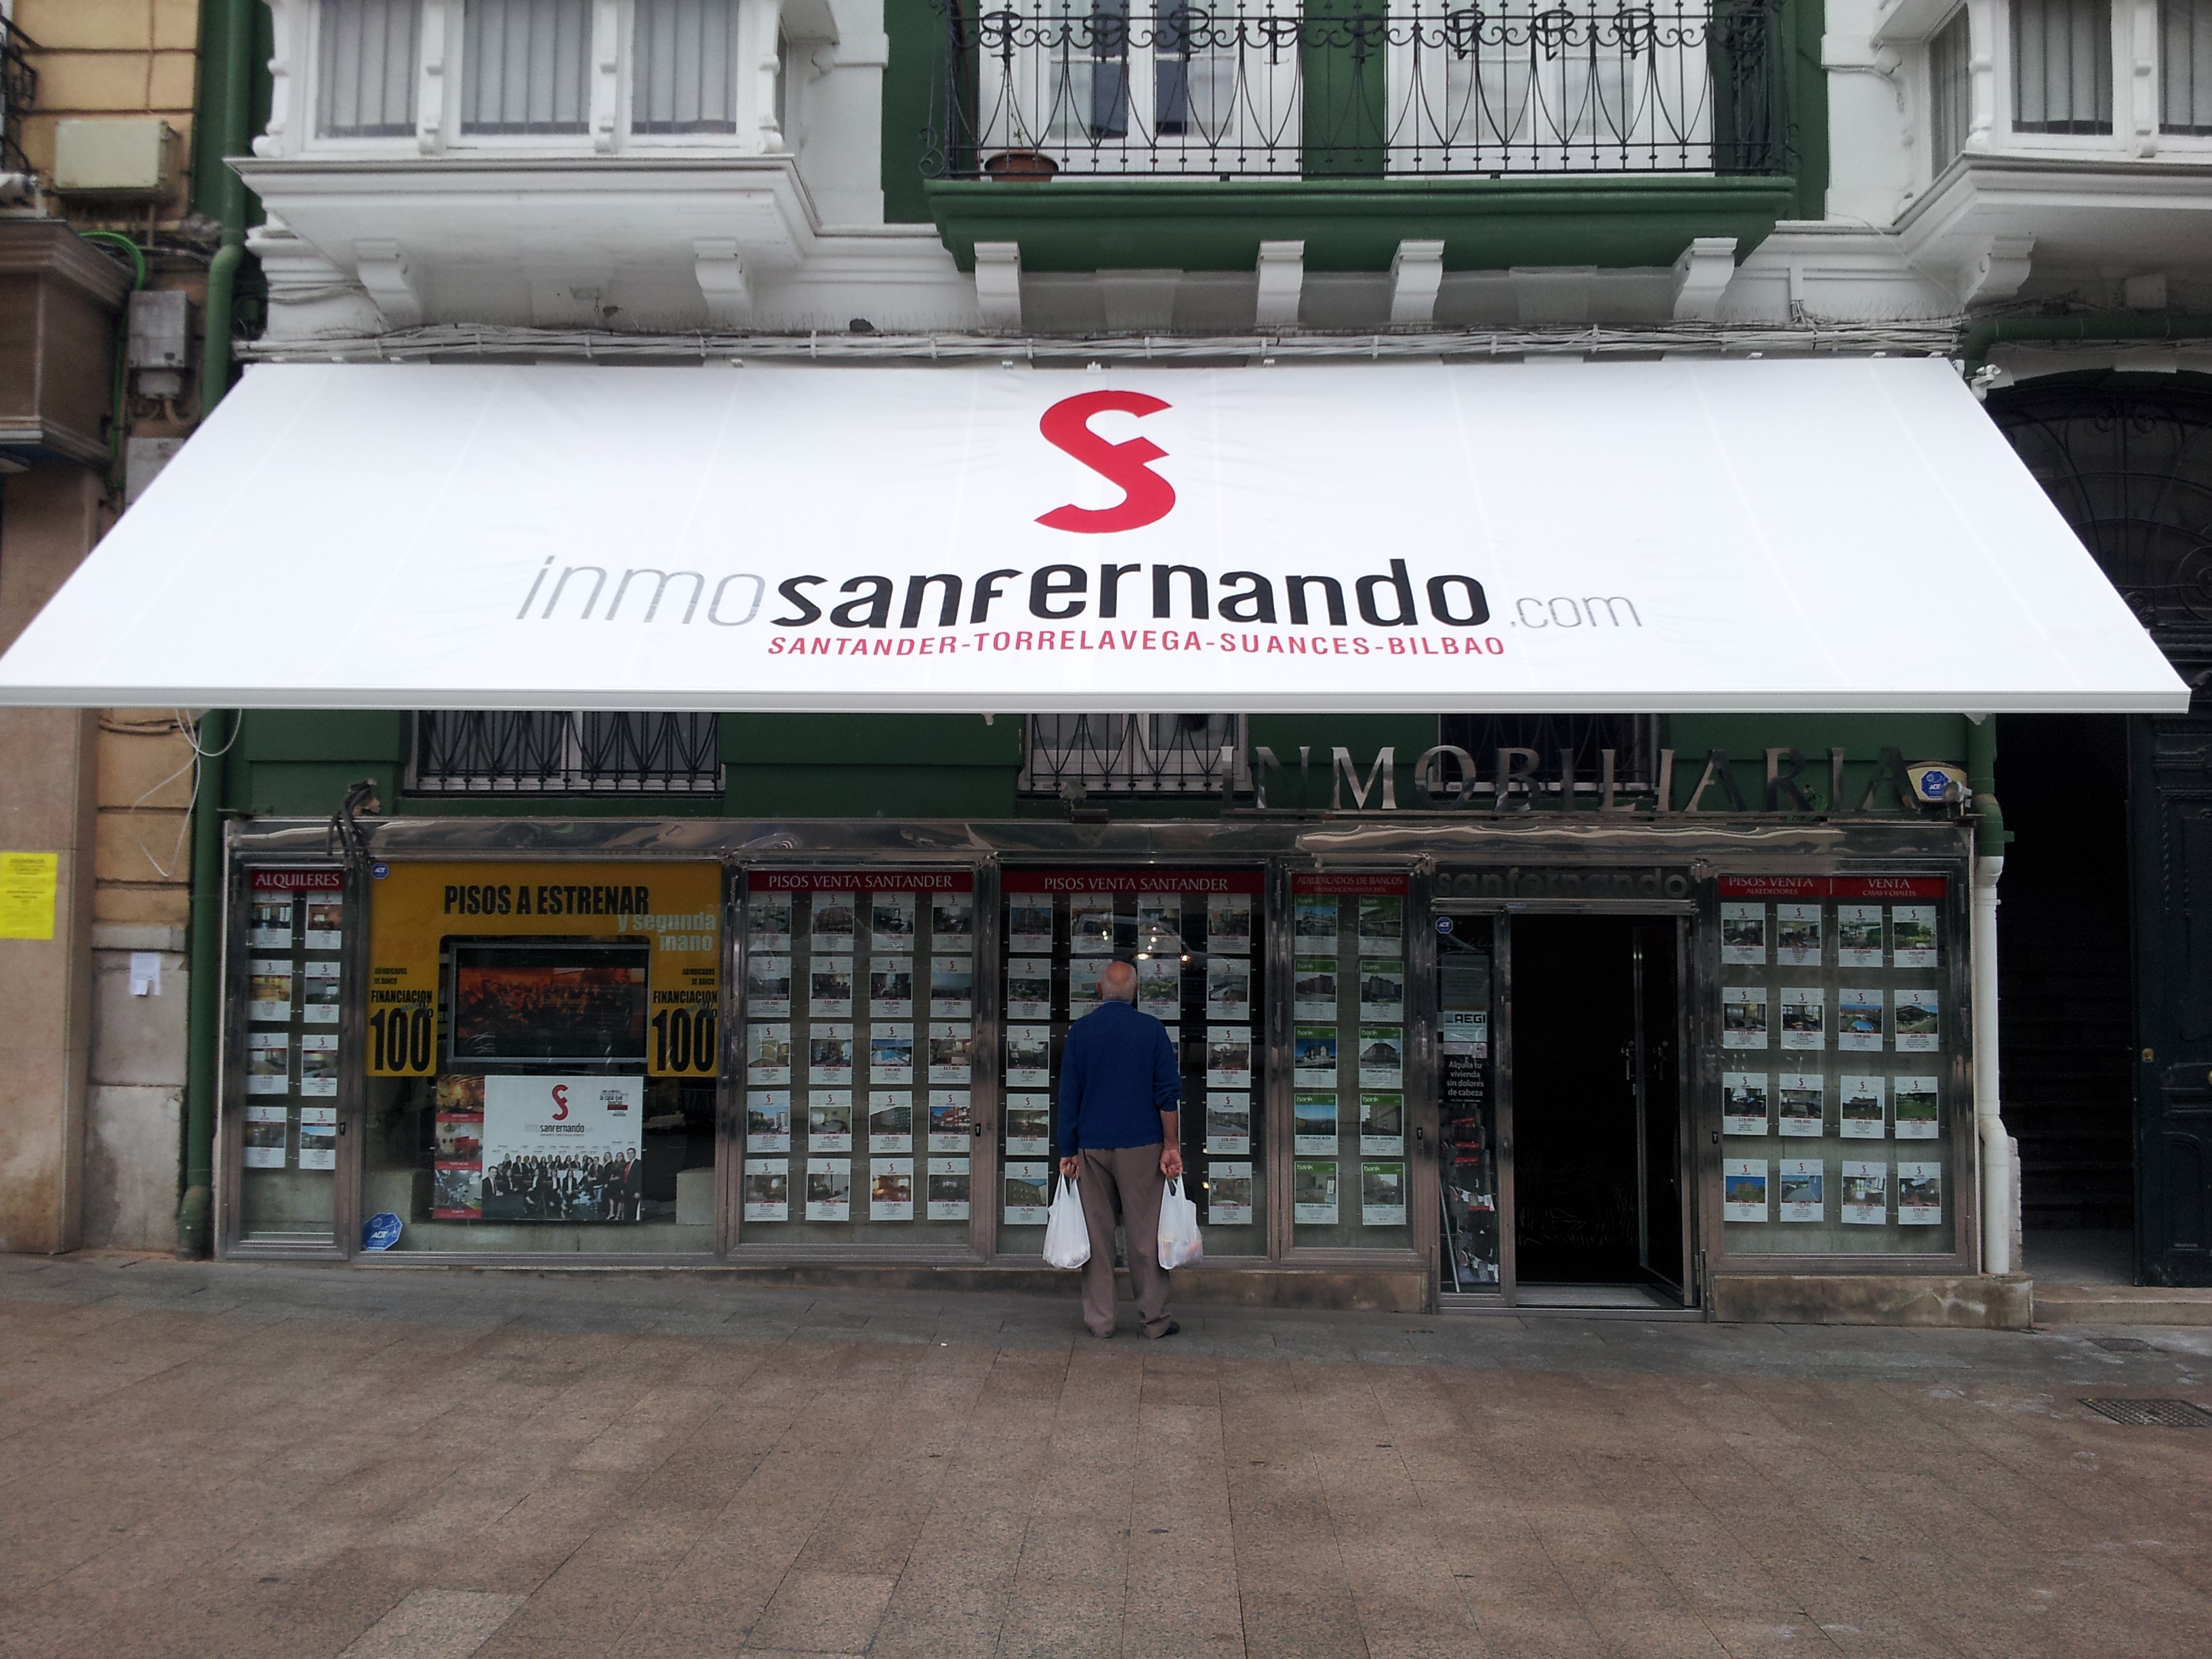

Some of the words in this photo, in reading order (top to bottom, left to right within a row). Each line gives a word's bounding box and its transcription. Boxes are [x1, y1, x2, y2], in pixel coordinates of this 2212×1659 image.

[1221, 745, 1923, 813] INMOBILIARIA
[255, 874, 340, 888] ALQUILERES
[769, 875, 808, 887] PISOS
[813, 875, 861, 887] VENTA
[865, 875, 952, 888] SANTANDER
[1044, 877, 1084, 890] PISOS
[1089, 878, 1136, 890] VENTA
[1140, 878, 1228, 890] SANTANDER
[1297, 877, 1354, 885] ADJUDICADOS
[1729, 876, 1765, 886] PISOS
[1769, 877, 1814, 887] VENTA
[1868, 879, 1910, 888] VENTA
[443, 885, 511, 914] PISOS
[516, 886, 531, 914] A
[536, 886, 649, 915] ESTRENAR
[617, 914, 628, 933] y
[632, 912, 716, 933] segunda
[659, 935, 714, 951] mano
[371, 990, 432, 1003] FINANCIACION
[653, 990, 718, 1003] FINANCIACION
[1448, 1061, 1473, 1070] Alquila
[371, 1230, 388, 1239] ADT
